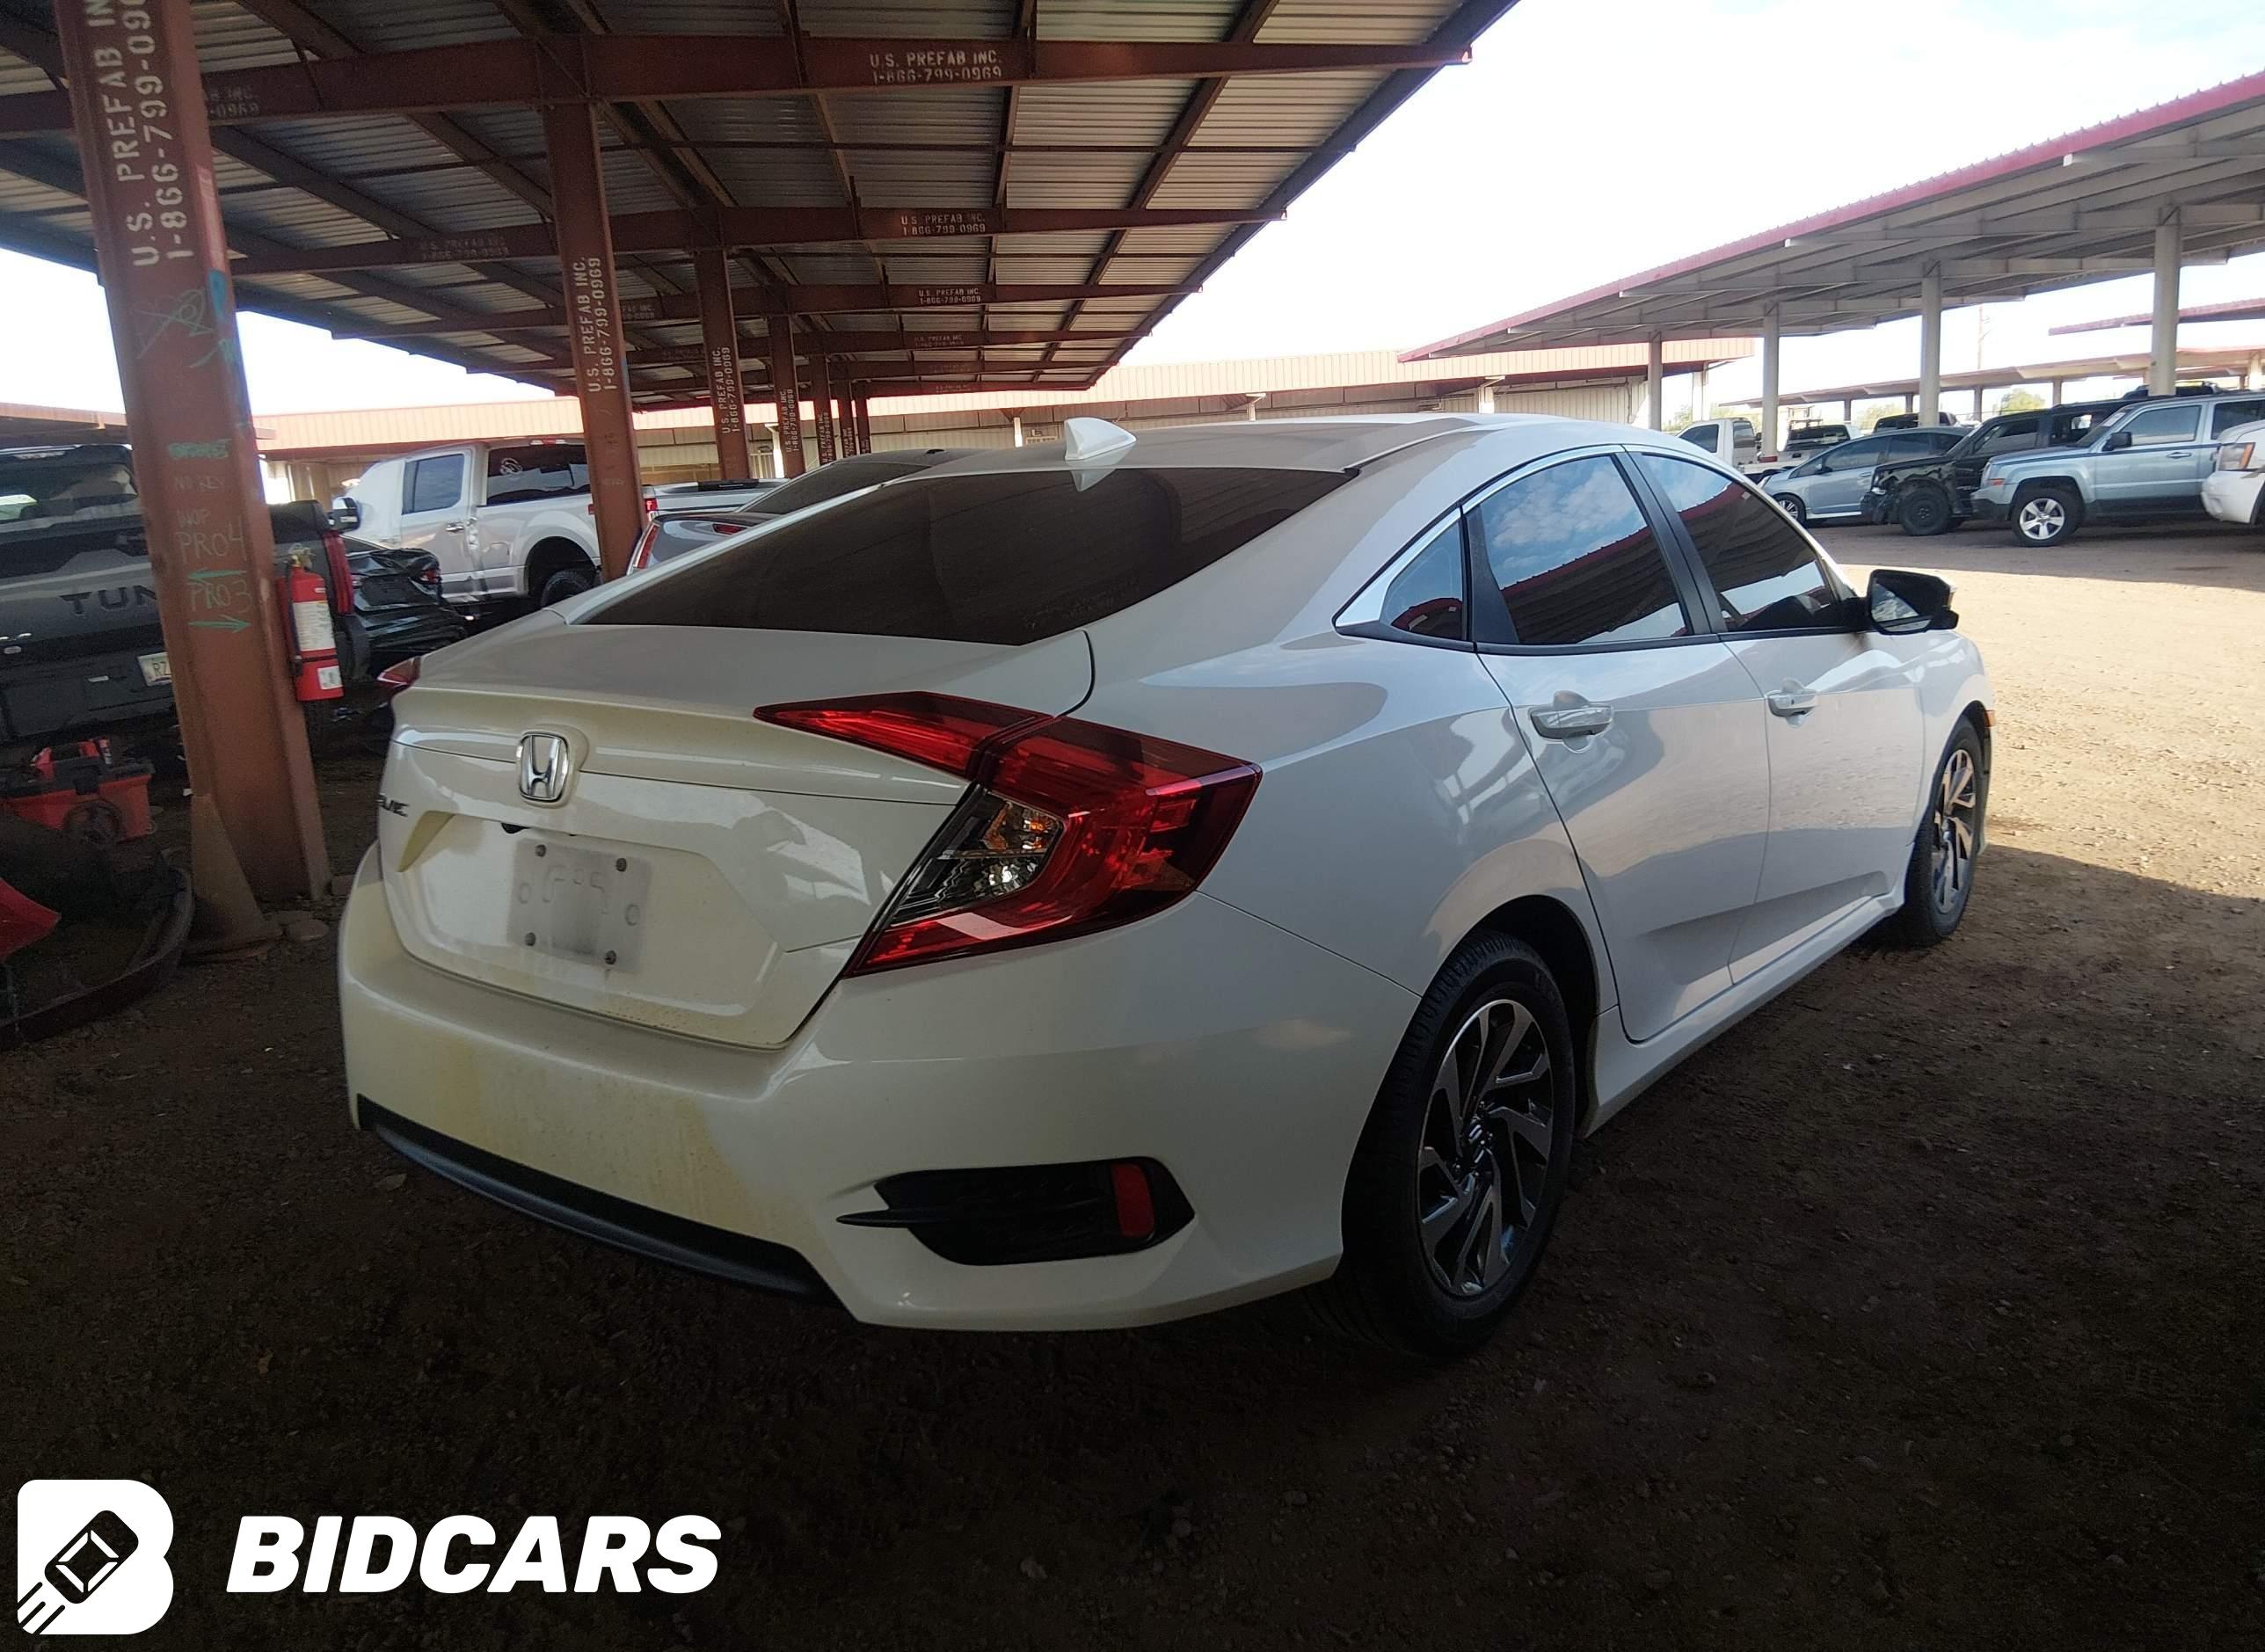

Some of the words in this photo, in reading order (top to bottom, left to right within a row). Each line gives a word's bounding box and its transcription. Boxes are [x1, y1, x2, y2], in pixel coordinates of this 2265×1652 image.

[872, 66, 1002, 85] 1-866-799-0969
[907, 50, 965, 67] PREFAB
[972, 49, 1002, 65] INC.
[92, 47, 145, 181] PREFAB
[121, 0, 195, 259] 1-866-799-09
[125, 201, 160, 266] U.S.
[925, 213, 963, 224] PREFAB
[572, 257, 588, 287] INC.
[936, 287, 964, 296] PREFAB
[577, 295, 597, 355] PREFAB
[587, 257, 618, 390] 1-866-799-0969
[586, 363, 602, 393] U.S.
[714, 370, 727, 411] PREFAB
